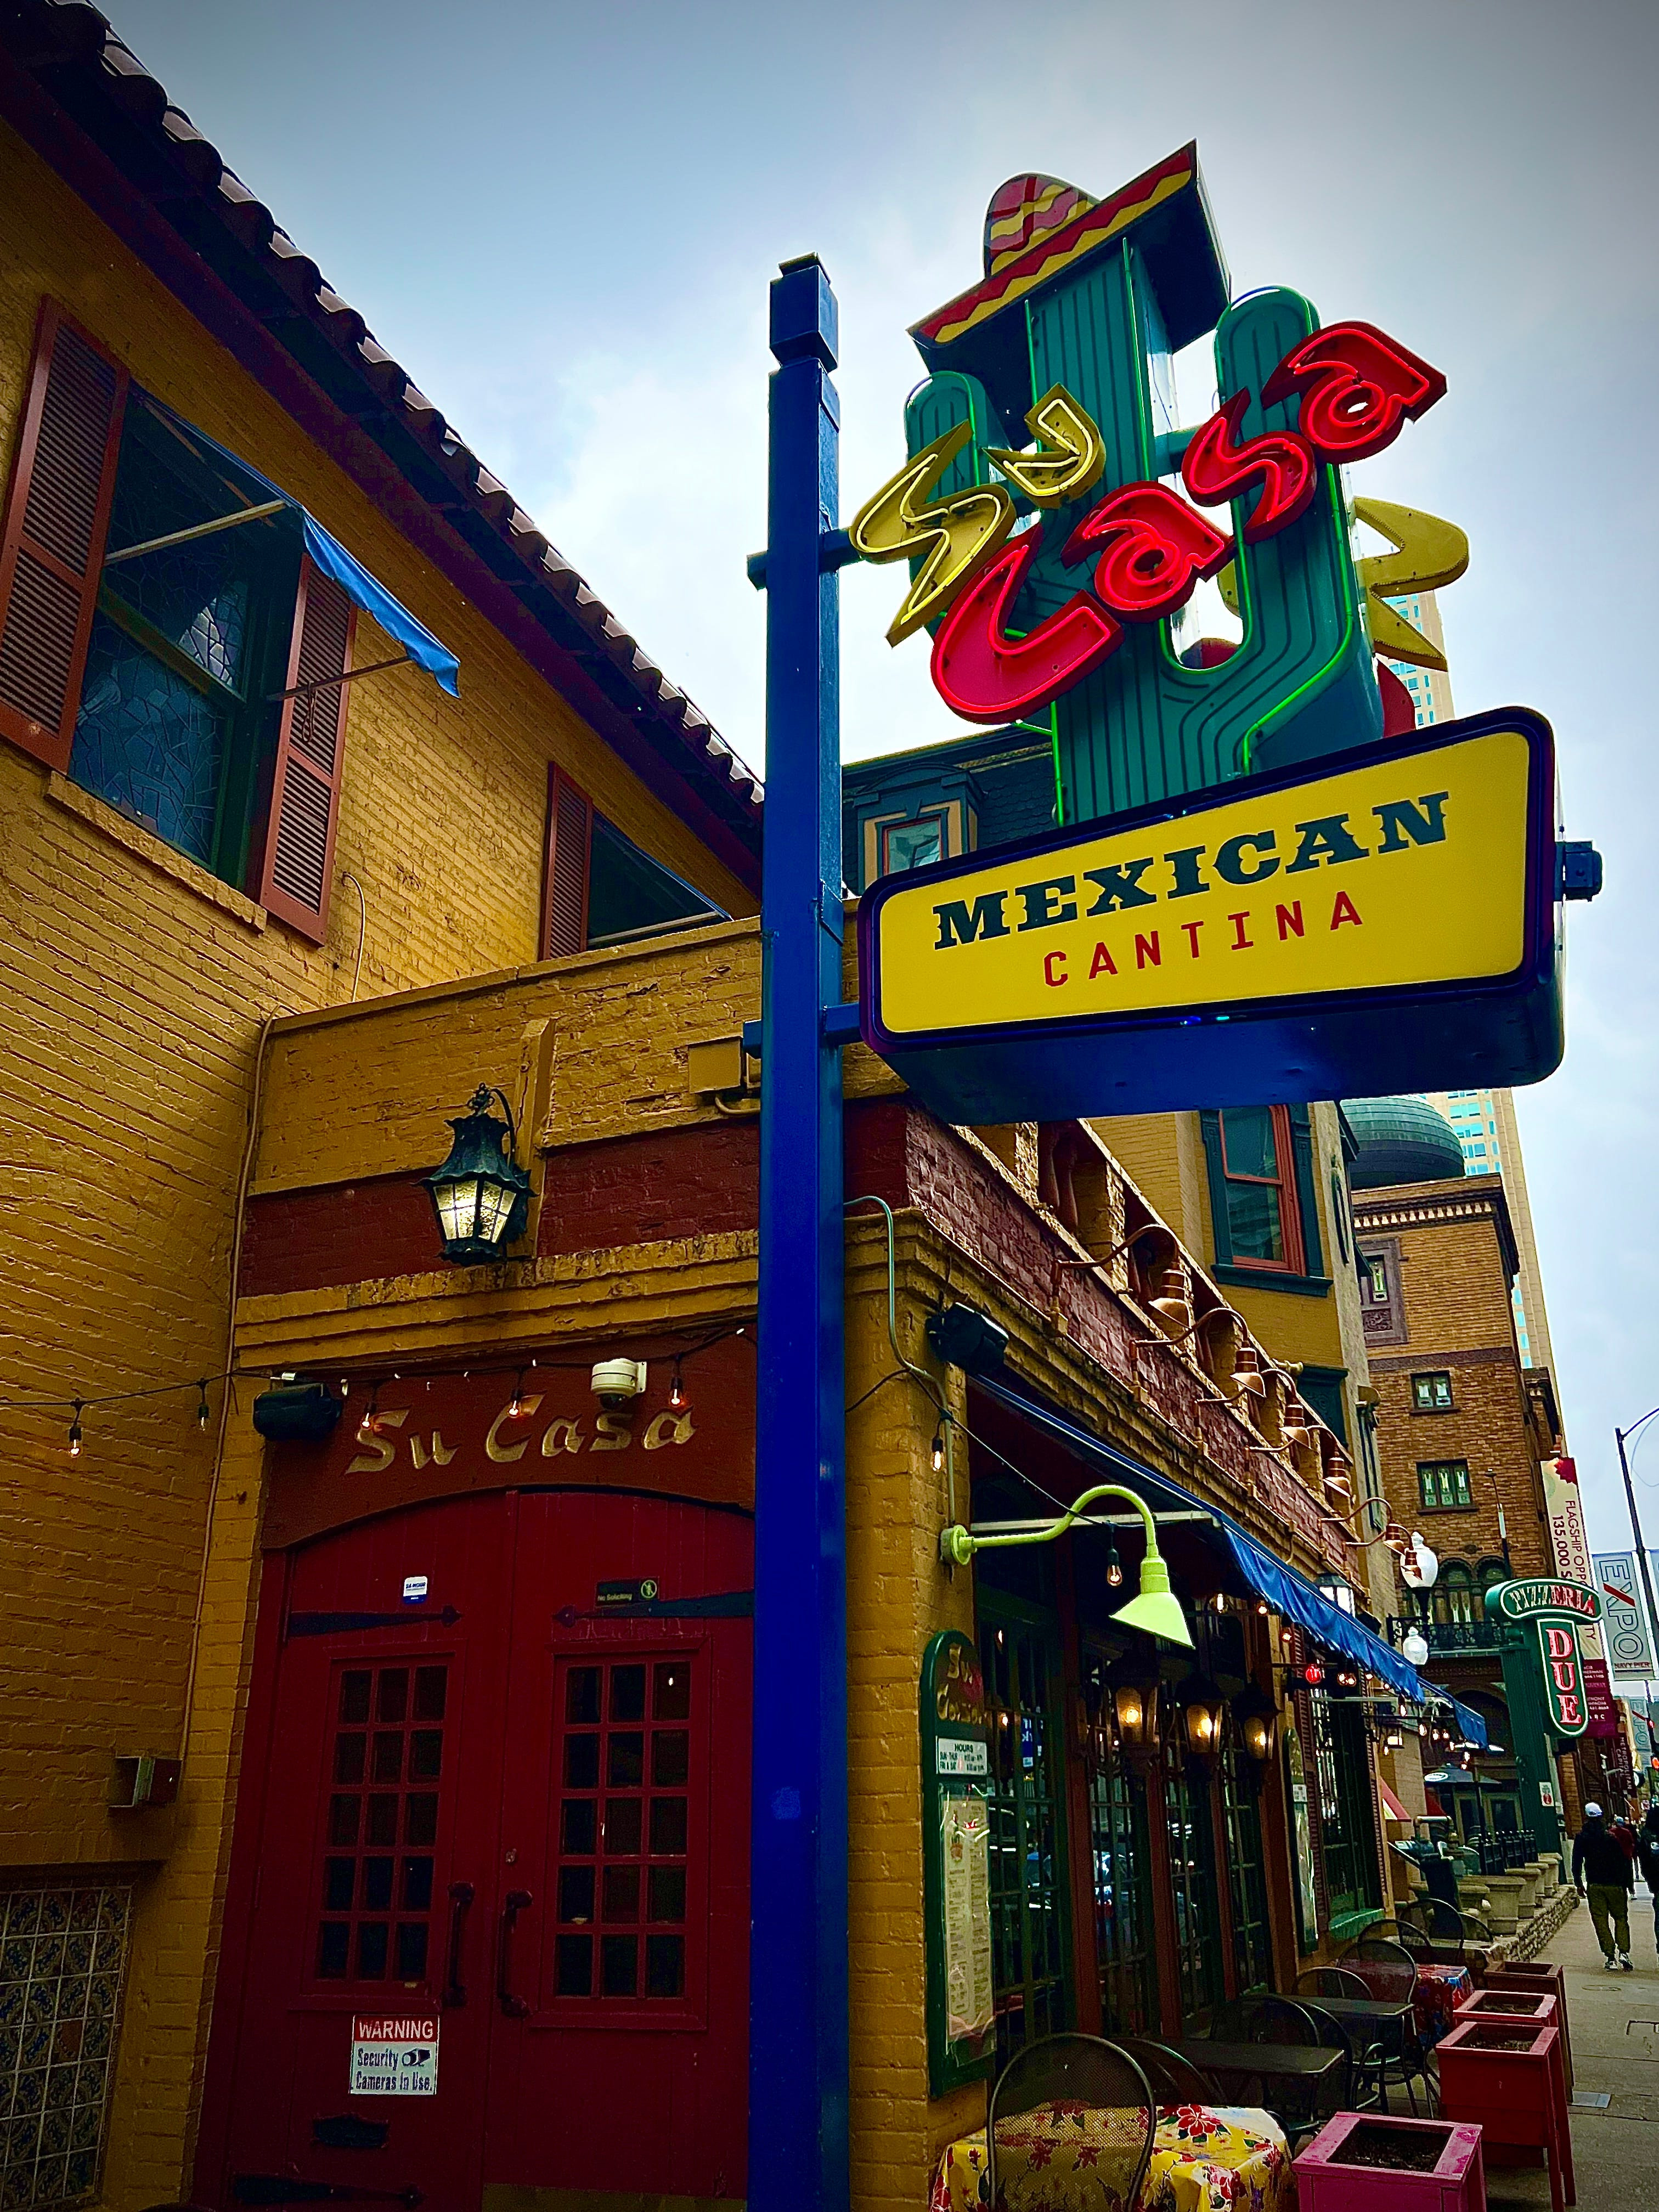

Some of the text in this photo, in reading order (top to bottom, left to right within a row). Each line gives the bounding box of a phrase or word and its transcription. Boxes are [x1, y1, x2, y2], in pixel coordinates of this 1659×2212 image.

[849, 321, 1448, 725] Su Casa
[932, 790, 1450, 951] MEXICAN
[1043, 890, 1363, 988] CANTINA
[345, 1390, 696, 1476] Su Casa
[1552, 1515, 1571, 1567] 135,000
[1565, 1500, 1583, 1553] FLAGSHIP
[1509, 1584, 1595, 1616] PIZZERIA
[1599, 1559, 1644, 1660] EXPO
[1545, 1628, 1582, 1725] DUE
[954, 1743, 974, 1753] HOURS
[1620, 1737, 1633, 1790] METROPOLITAN
[359, 2020, 433, 2039] WARNING
[356, 2070, 432, 2091] Cameras In Use.
[357, 2047, 399, 2072] Security
